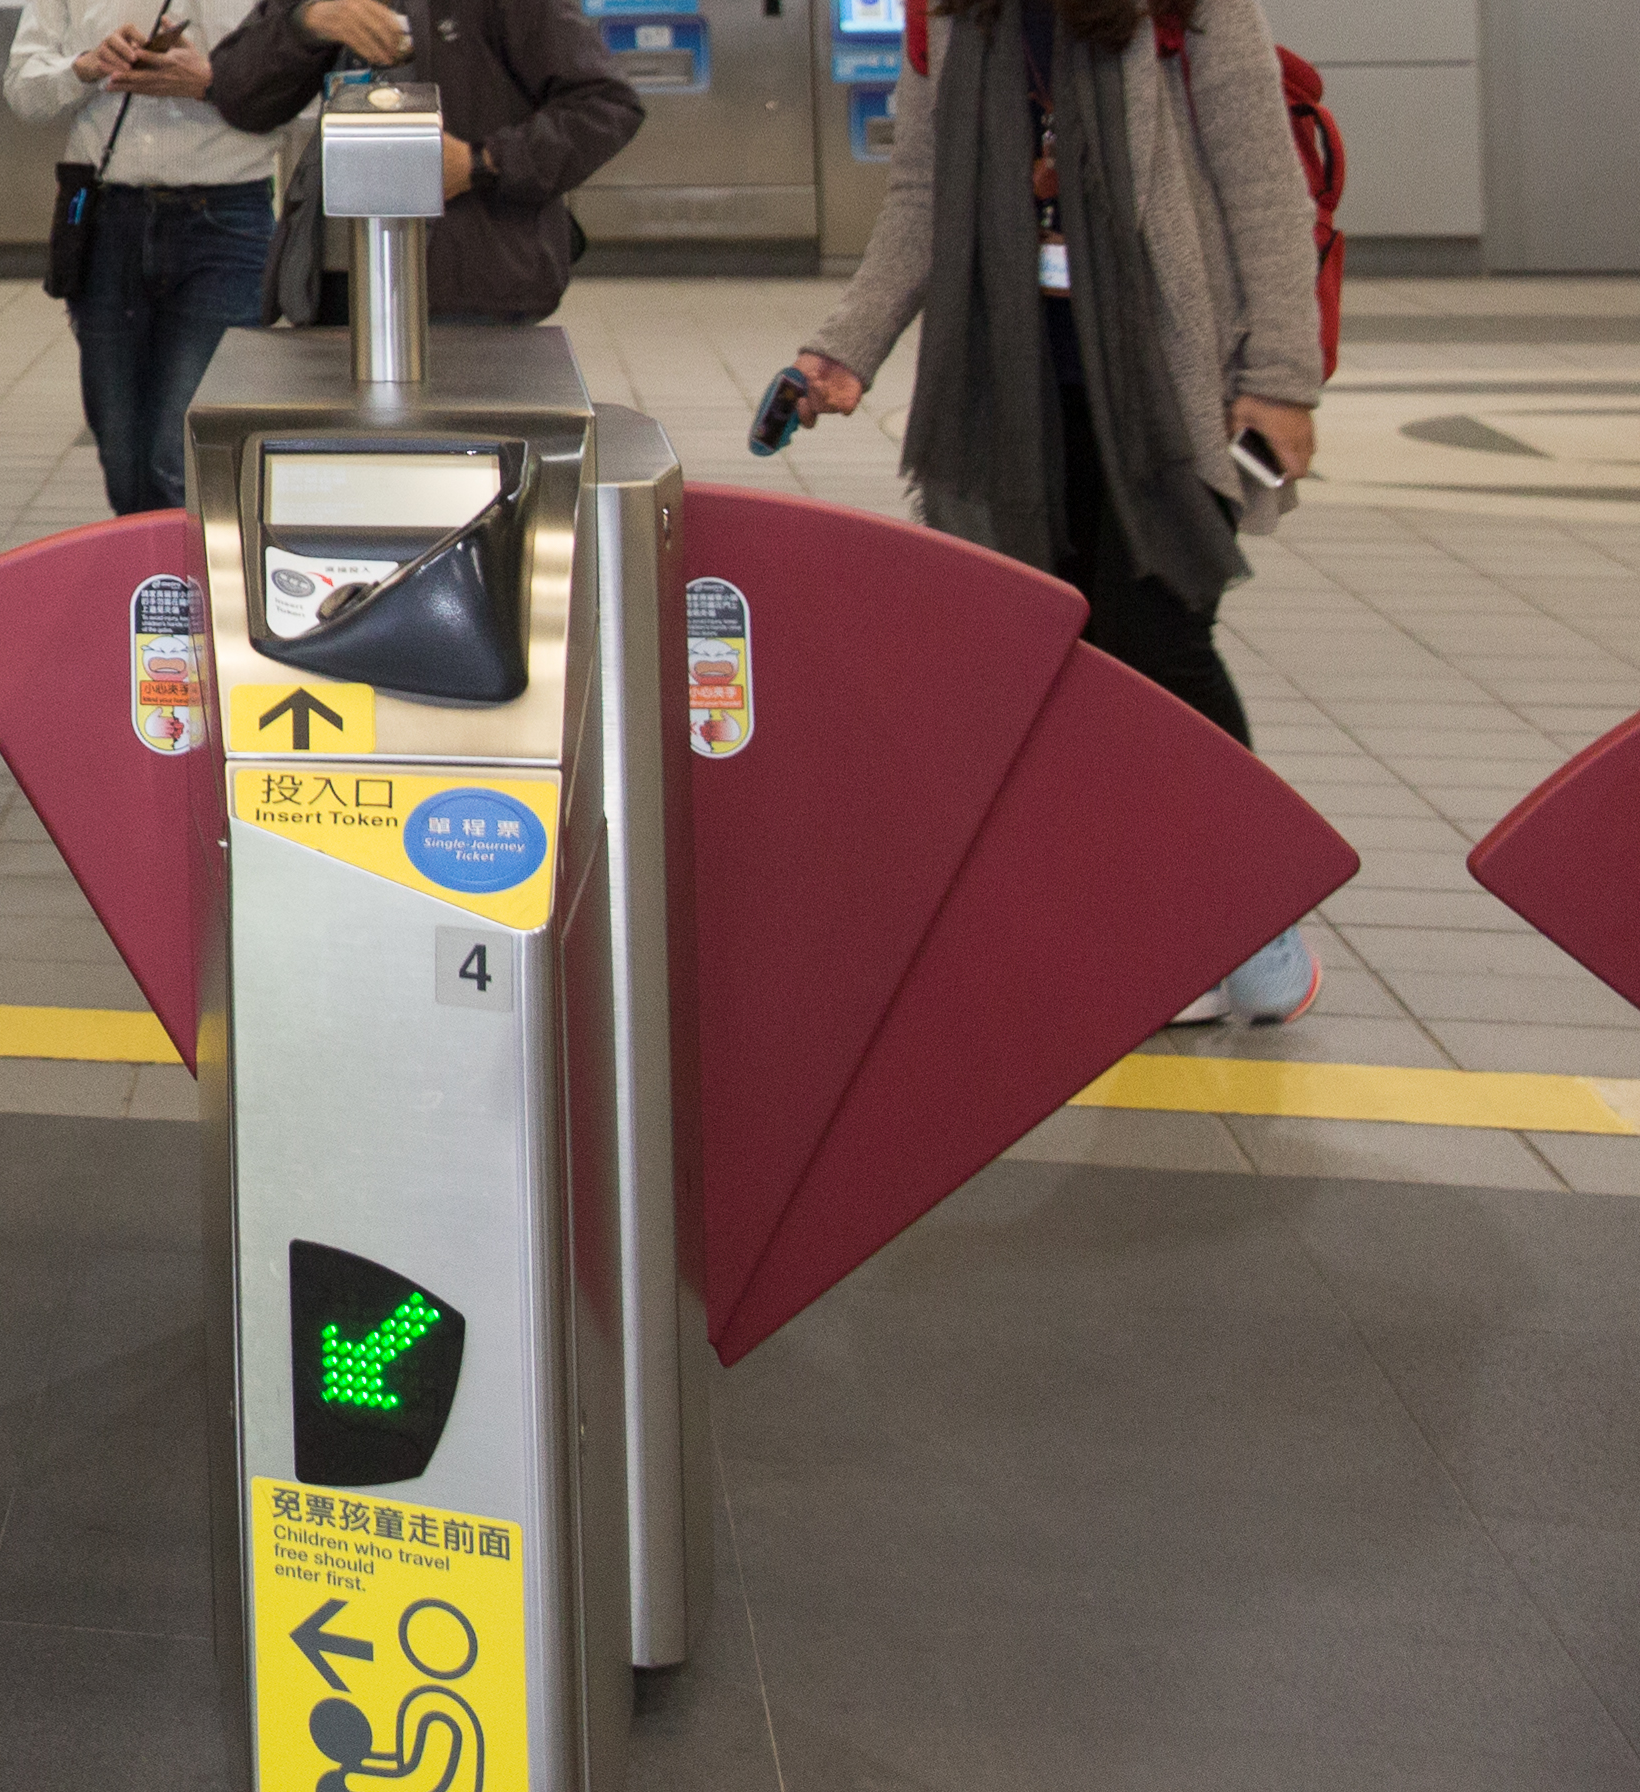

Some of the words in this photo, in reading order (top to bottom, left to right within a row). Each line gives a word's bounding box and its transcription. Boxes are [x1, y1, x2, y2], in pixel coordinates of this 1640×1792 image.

[261, 774, 393, 809] 投入口
[255, 808, 322, 824] Insert
[331, 811, 398, 828] Token
[428, 817, 520, 838] 單程票
[455, 850, 495, 862] Ticket
[458, 943, 492, 992] 4
[271, 1487, 511, 1561] 免票孩童走前面
[273, 1524, 349, 1552] Children
[354, 1542, 393, 1560] who
[398, 1548, 450, 1571] travel
[273, 1543, 309, 1562] free
[313, 1550, 375, 1575] should
[274, 1564, 322, 1584] enter
[326, 1570, 366, 1592] first.
